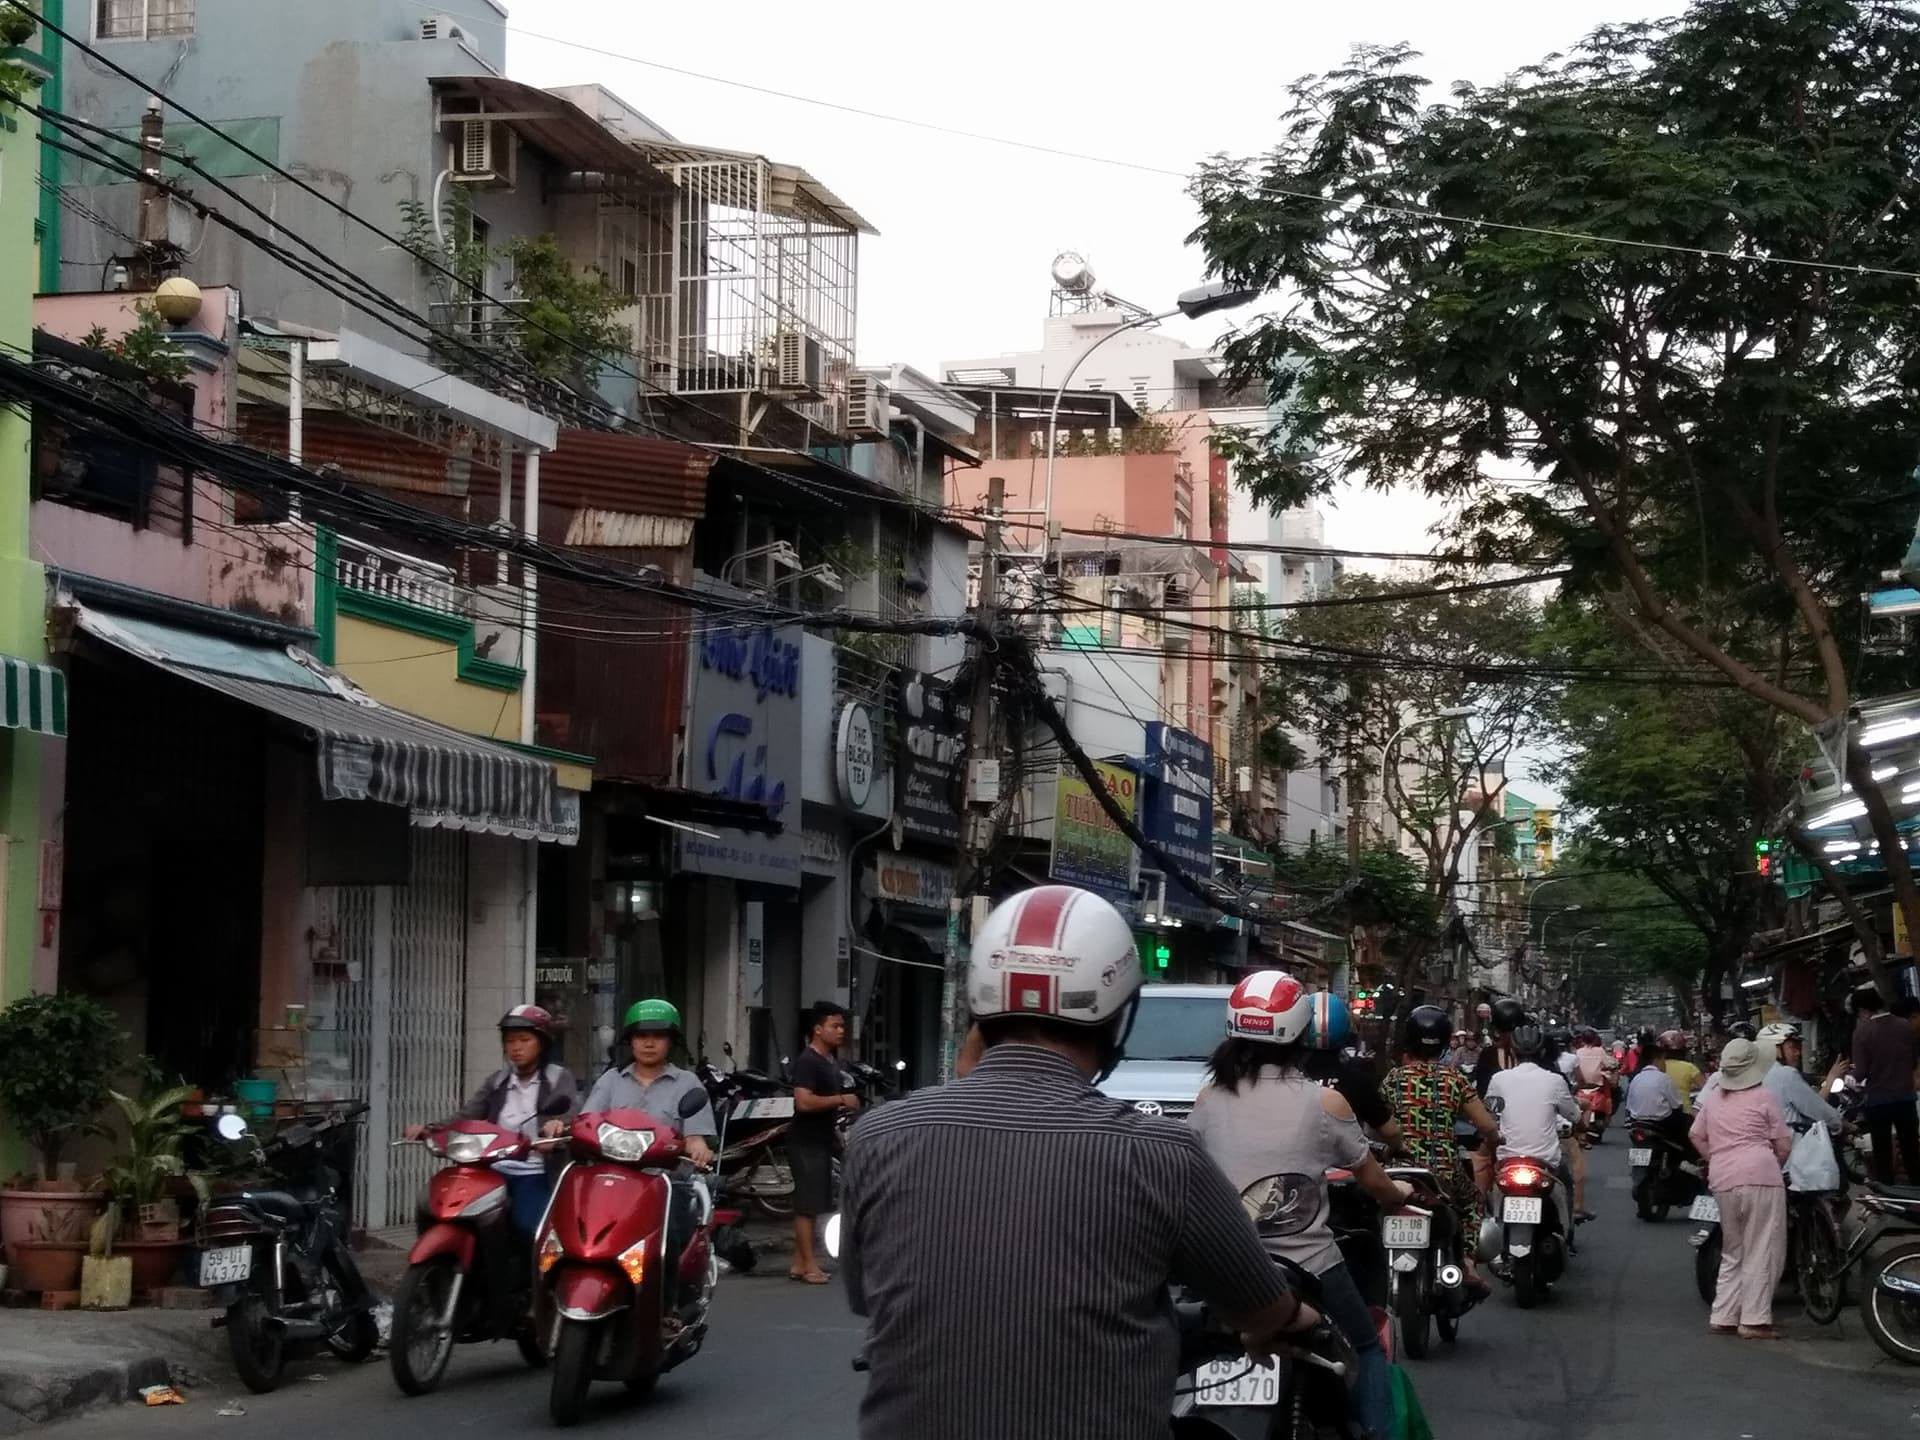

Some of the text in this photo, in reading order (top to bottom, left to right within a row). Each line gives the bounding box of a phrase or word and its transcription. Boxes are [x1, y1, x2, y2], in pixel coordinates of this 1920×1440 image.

[854, 725, 867, 745] THE
[848, 744, 872, 768] BLACK
[853, 766, 866, 785] TEA
[1242, 1017, 1270, 1026] DENSO
[1391, 1231, 1422, 1242] 4004
